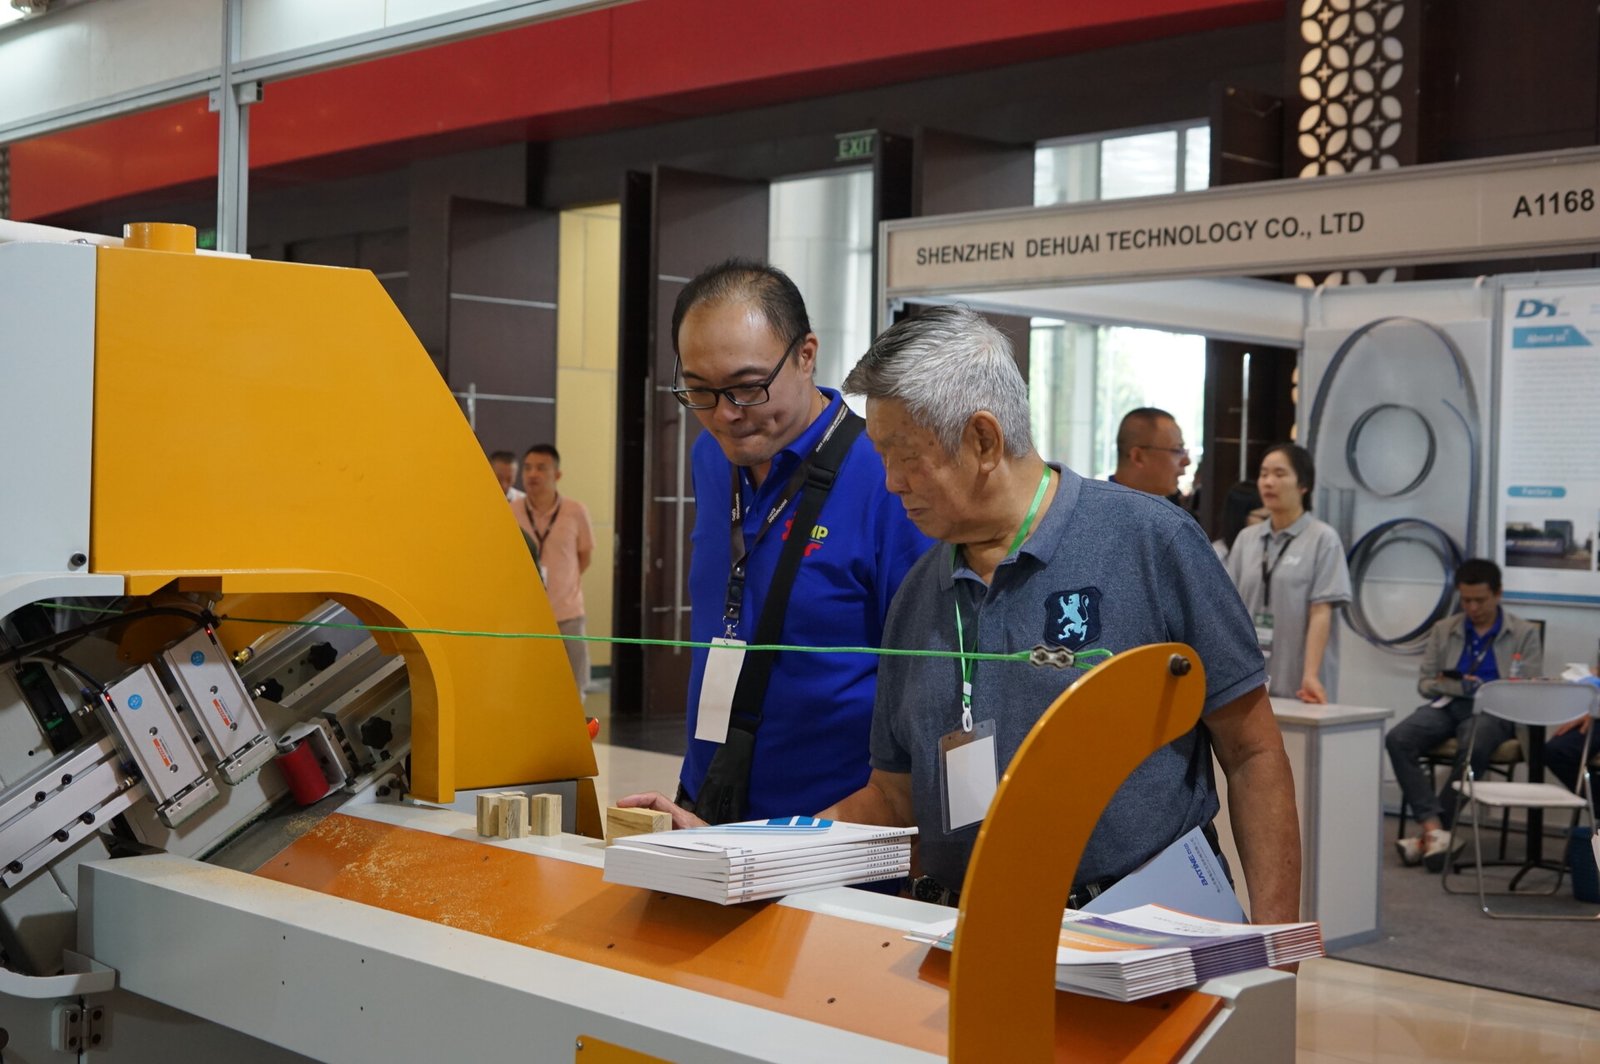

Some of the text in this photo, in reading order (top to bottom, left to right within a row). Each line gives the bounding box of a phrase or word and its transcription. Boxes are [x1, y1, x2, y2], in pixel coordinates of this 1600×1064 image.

[839, 136, 873, 157] EXIT
[1512, 188, 1595, 219] A1168
[916, 211, 1365, 266] SHENZHEN DEHUAI TECHNOLOGY CO., LTD
